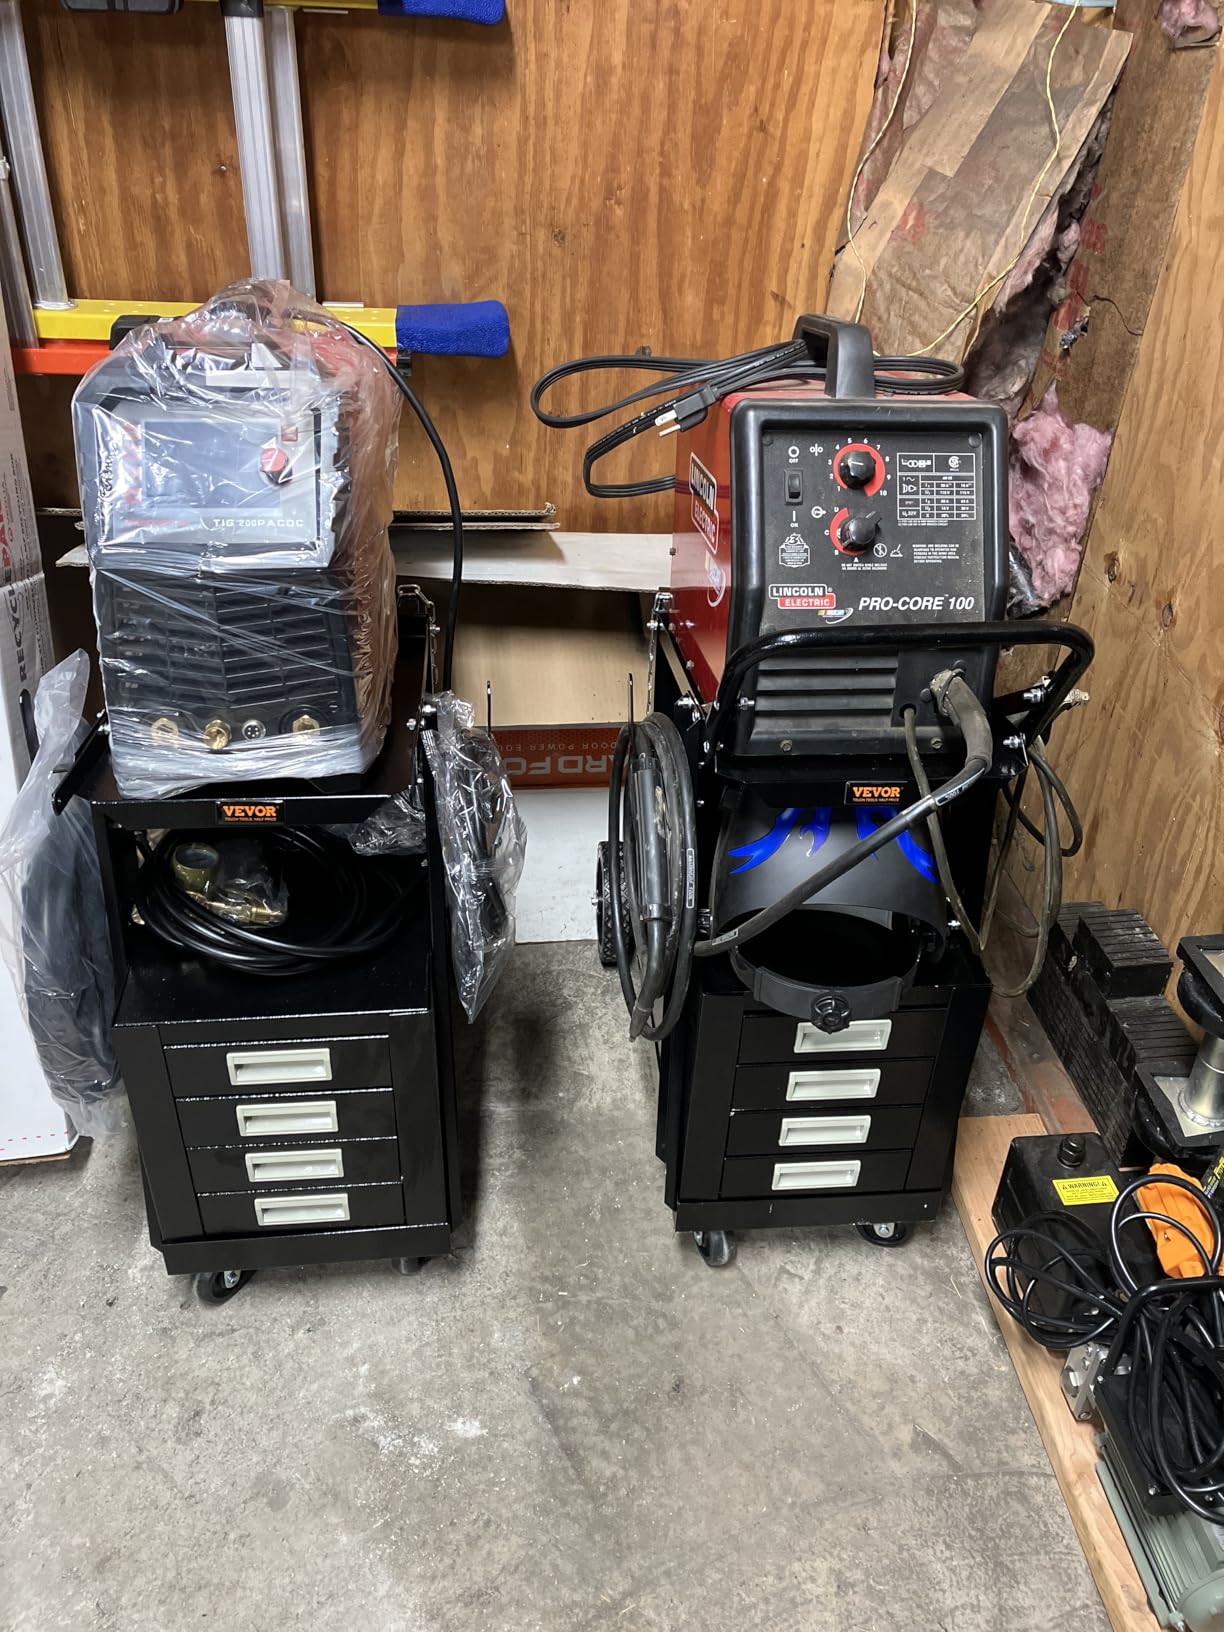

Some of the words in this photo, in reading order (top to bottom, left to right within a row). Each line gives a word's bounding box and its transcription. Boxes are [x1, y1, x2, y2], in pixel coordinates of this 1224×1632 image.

[691, 462, 715, 511] LINCOLN
[213, 519, 234, 527] TIG
[694, 500, 716, 544] ELECTRIC
[772, 586, 824, 596] LINCOLN
[784, 598, 831, 606] ELECTRIC
[858, 596, 944, 611] PRO-CORE
[948, 596, 974, 610] 100
[530, 743, 574, 751] POWER
[852, 786, 900, 798] VEVOR
[222, 806, 277, 816] VEVOR
